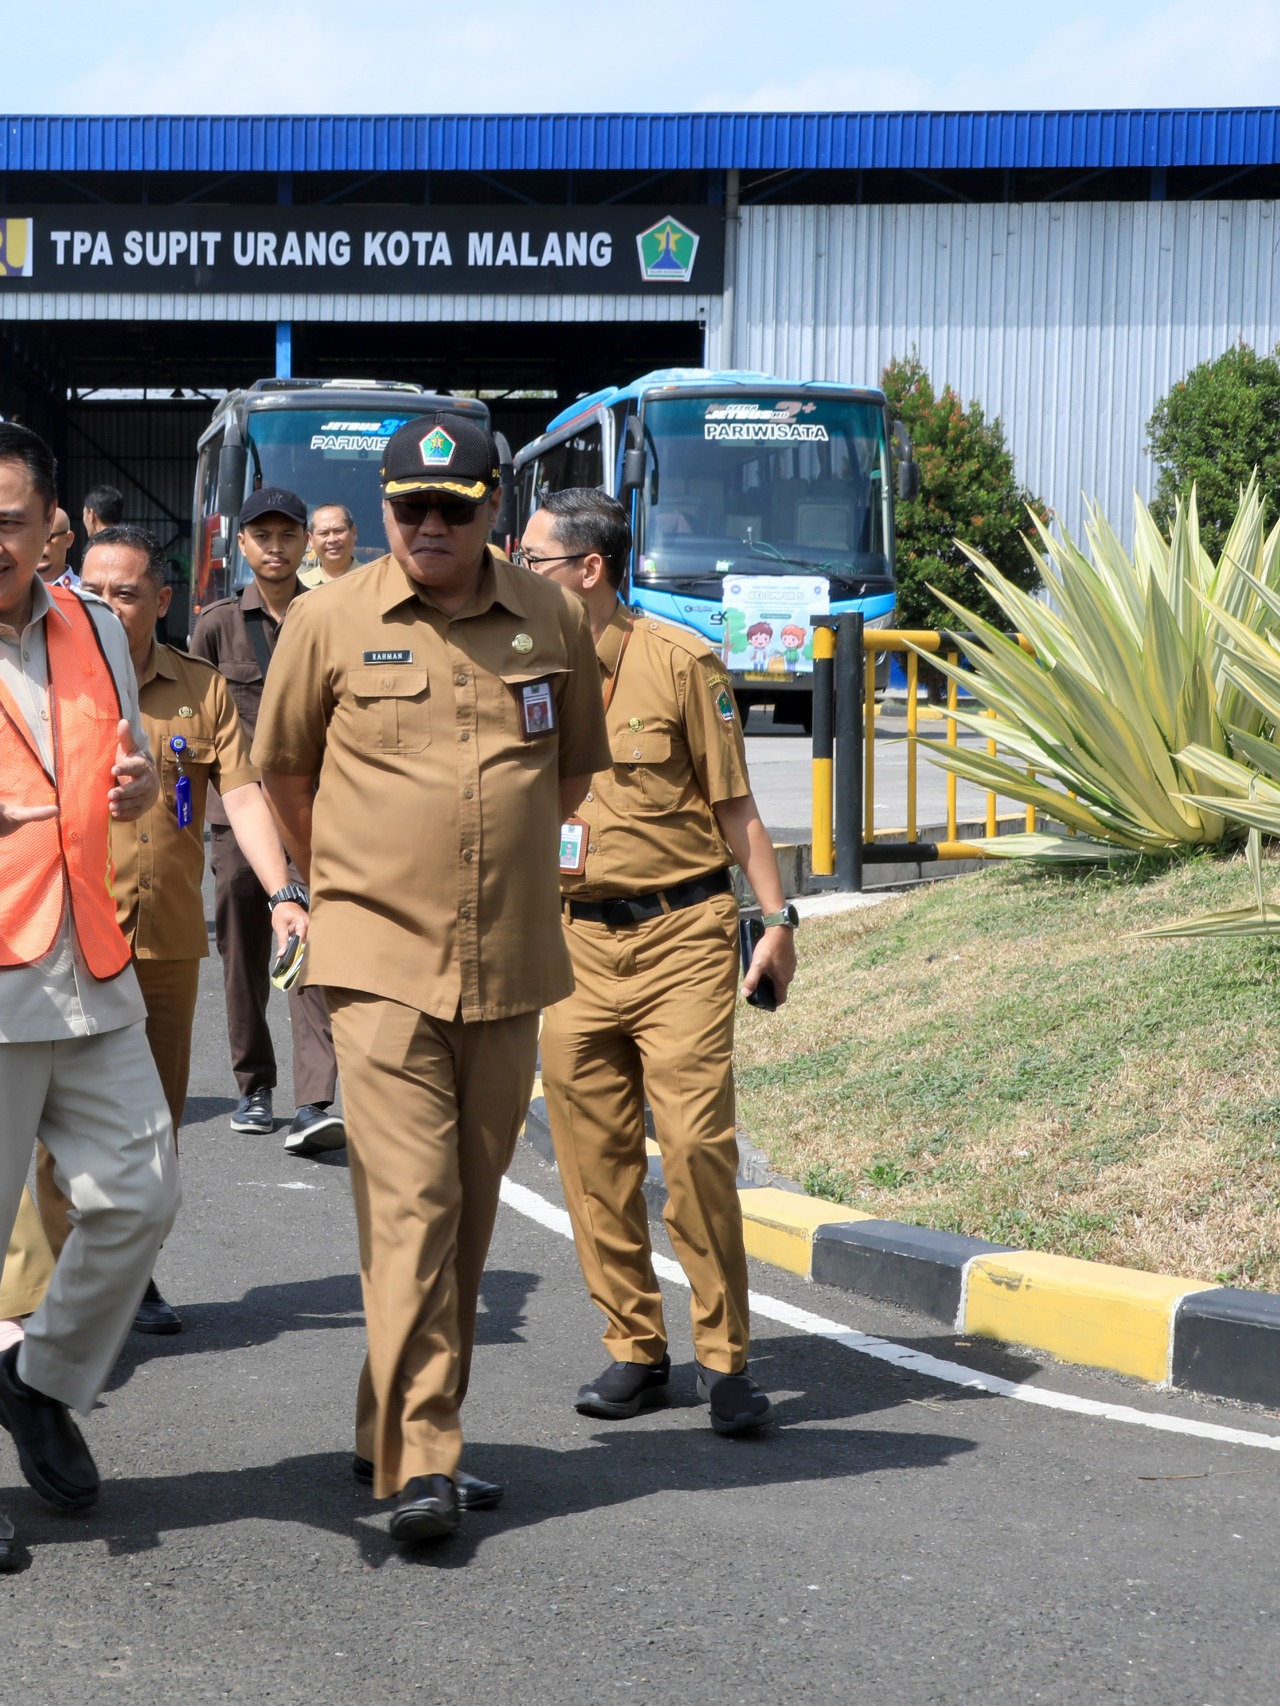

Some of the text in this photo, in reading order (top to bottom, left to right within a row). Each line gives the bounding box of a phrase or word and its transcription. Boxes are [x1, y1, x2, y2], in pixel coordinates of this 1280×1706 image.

[50, 231, 613, 267] TPA SUPIT URANG KOTA MALANG
[704, 410, 773, 420] JETBUS
[321, 421, 382, 431] JETBUS
[704, 423, 830, 441] PARIWISATA
[310, 435, 391, 451] PARIWIS
[749, 591, 795, 600] KELOMPOK
[372, 652, 403, 661] RAHMAN
